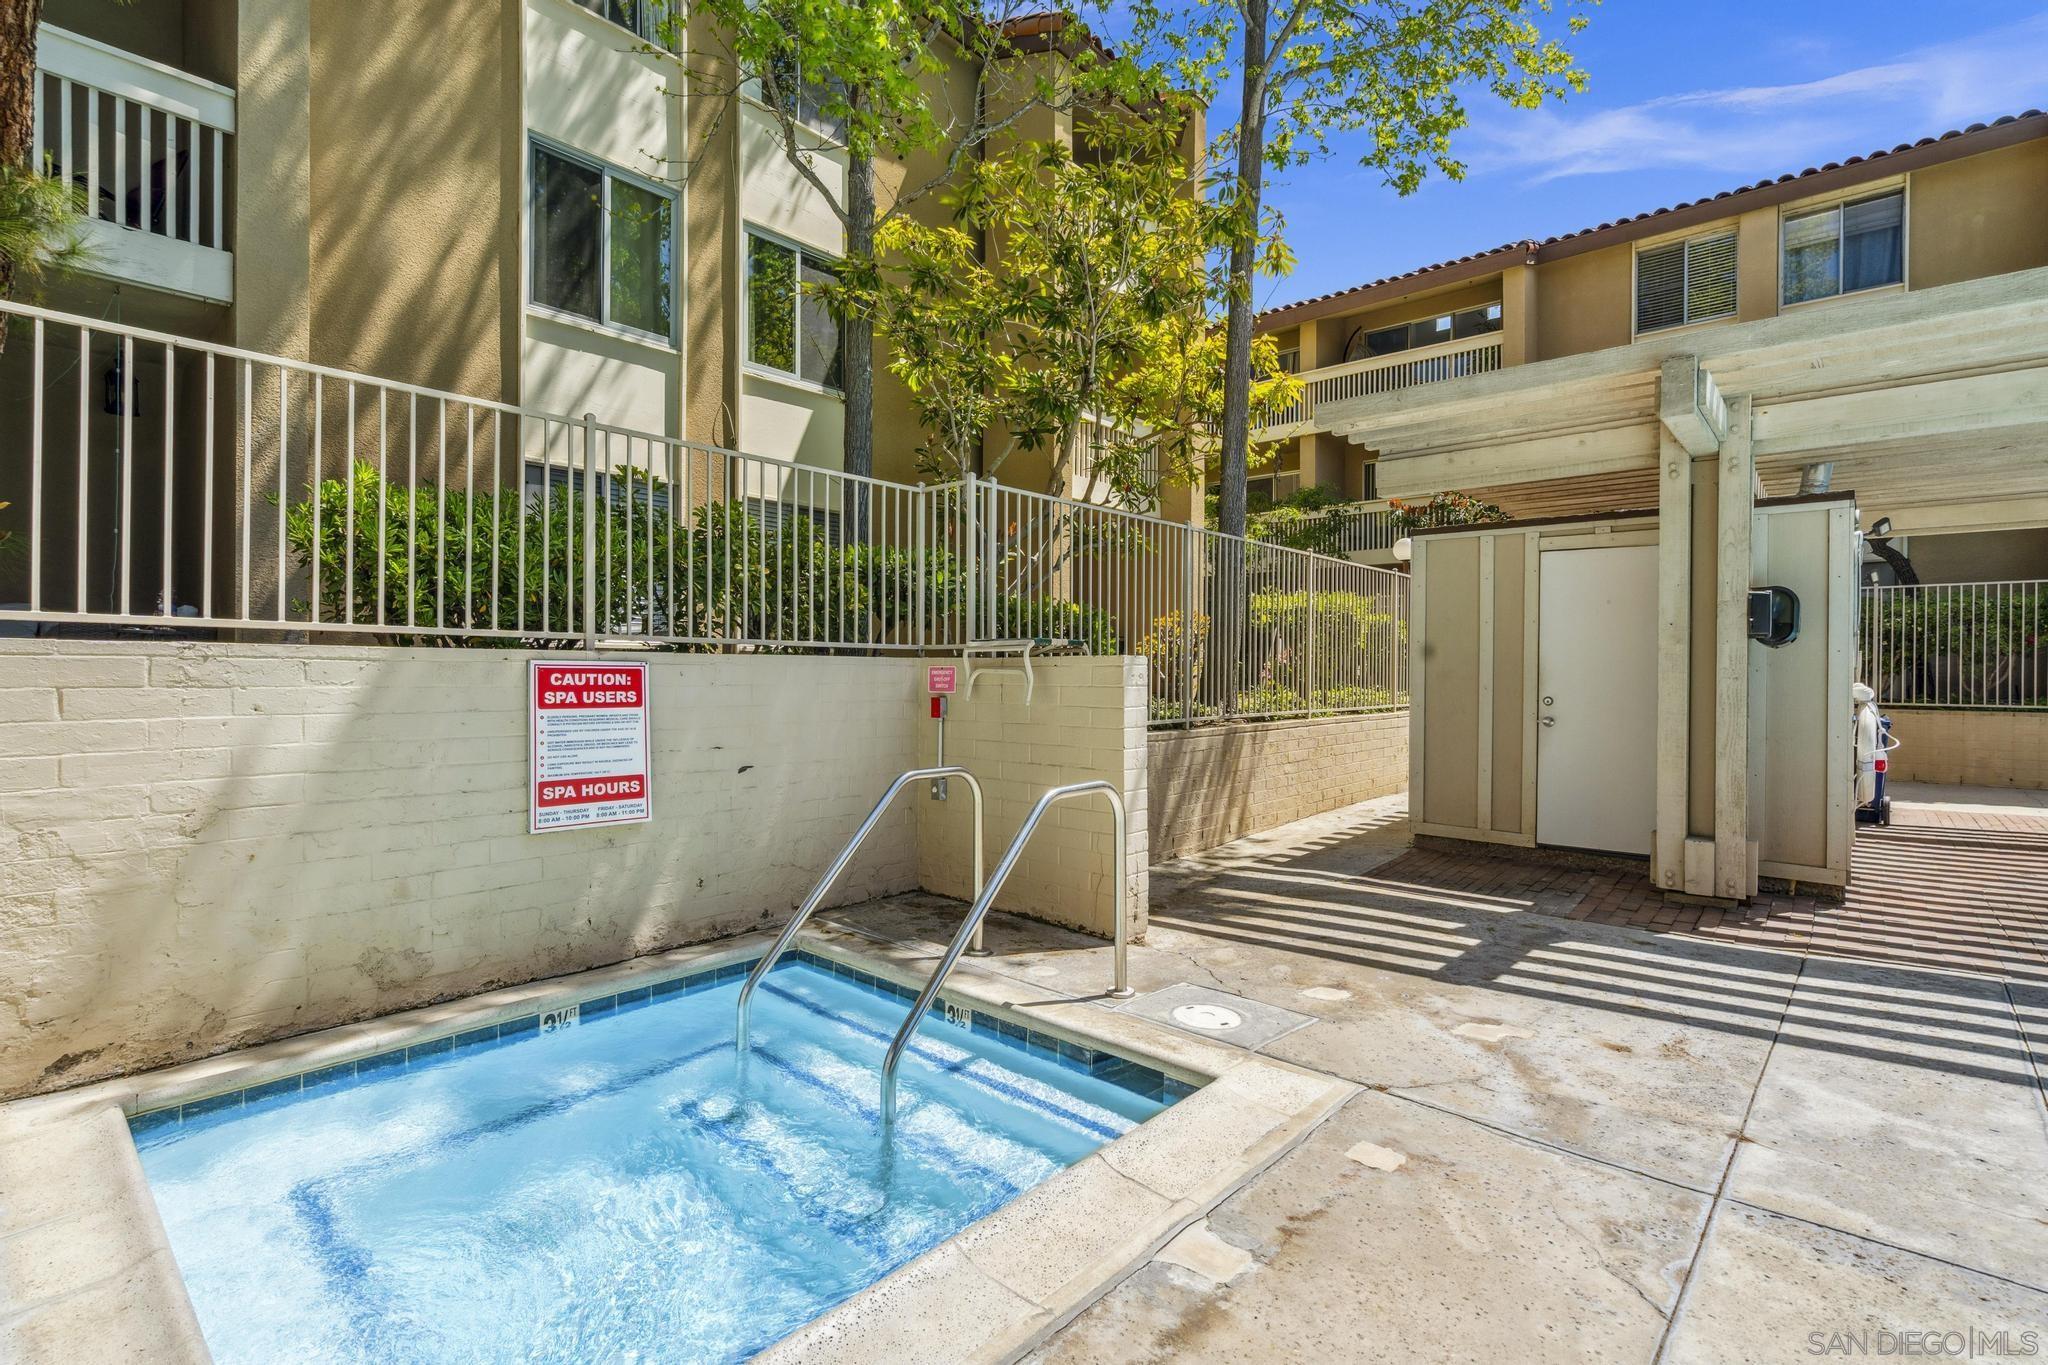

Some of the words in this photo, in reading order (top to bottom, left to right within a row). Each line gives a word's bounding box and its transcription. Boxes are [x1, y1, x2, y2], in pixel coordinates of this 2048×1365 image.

[550, 673, 632, 686] CAUTION:
[544, 691, 578, 704] SPA
[582, 691, 637, 703] USERS
[542, 785, 577, 800] SPA
[581, 780, 641, 797] HOURS
